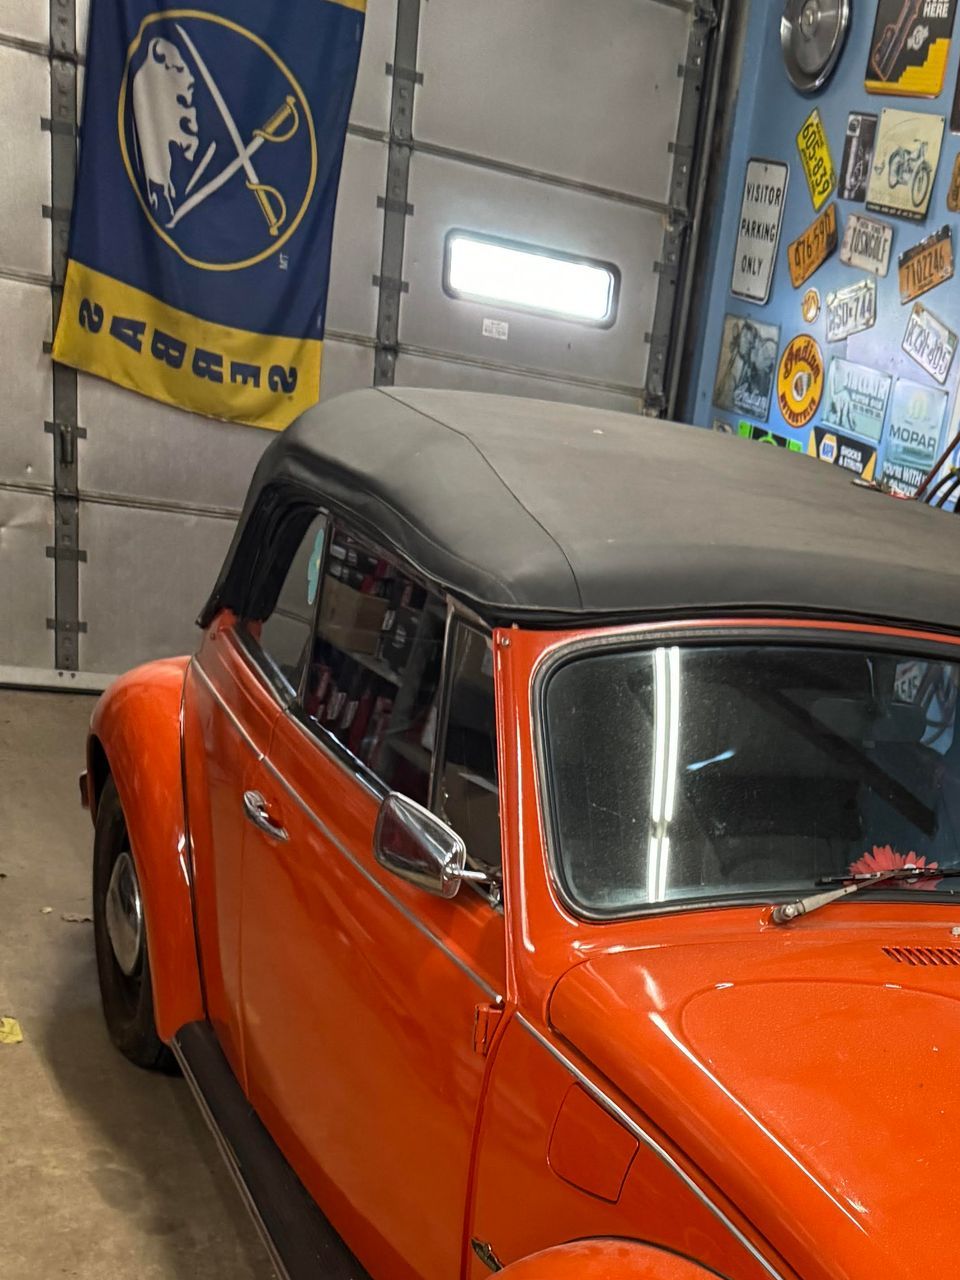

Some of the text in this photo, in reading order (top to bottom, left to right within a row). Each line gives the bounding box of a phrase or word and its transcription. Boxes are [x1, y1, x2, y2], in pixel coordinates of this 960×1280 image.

[923, 3, 949, 18] HERE
[747, 184, 781, 205] VISITOR
[741, 218, 776, 243] PARKING
[741, 255, 763, 276] ONLY
[889, 424, 936, 451] MOPAR
